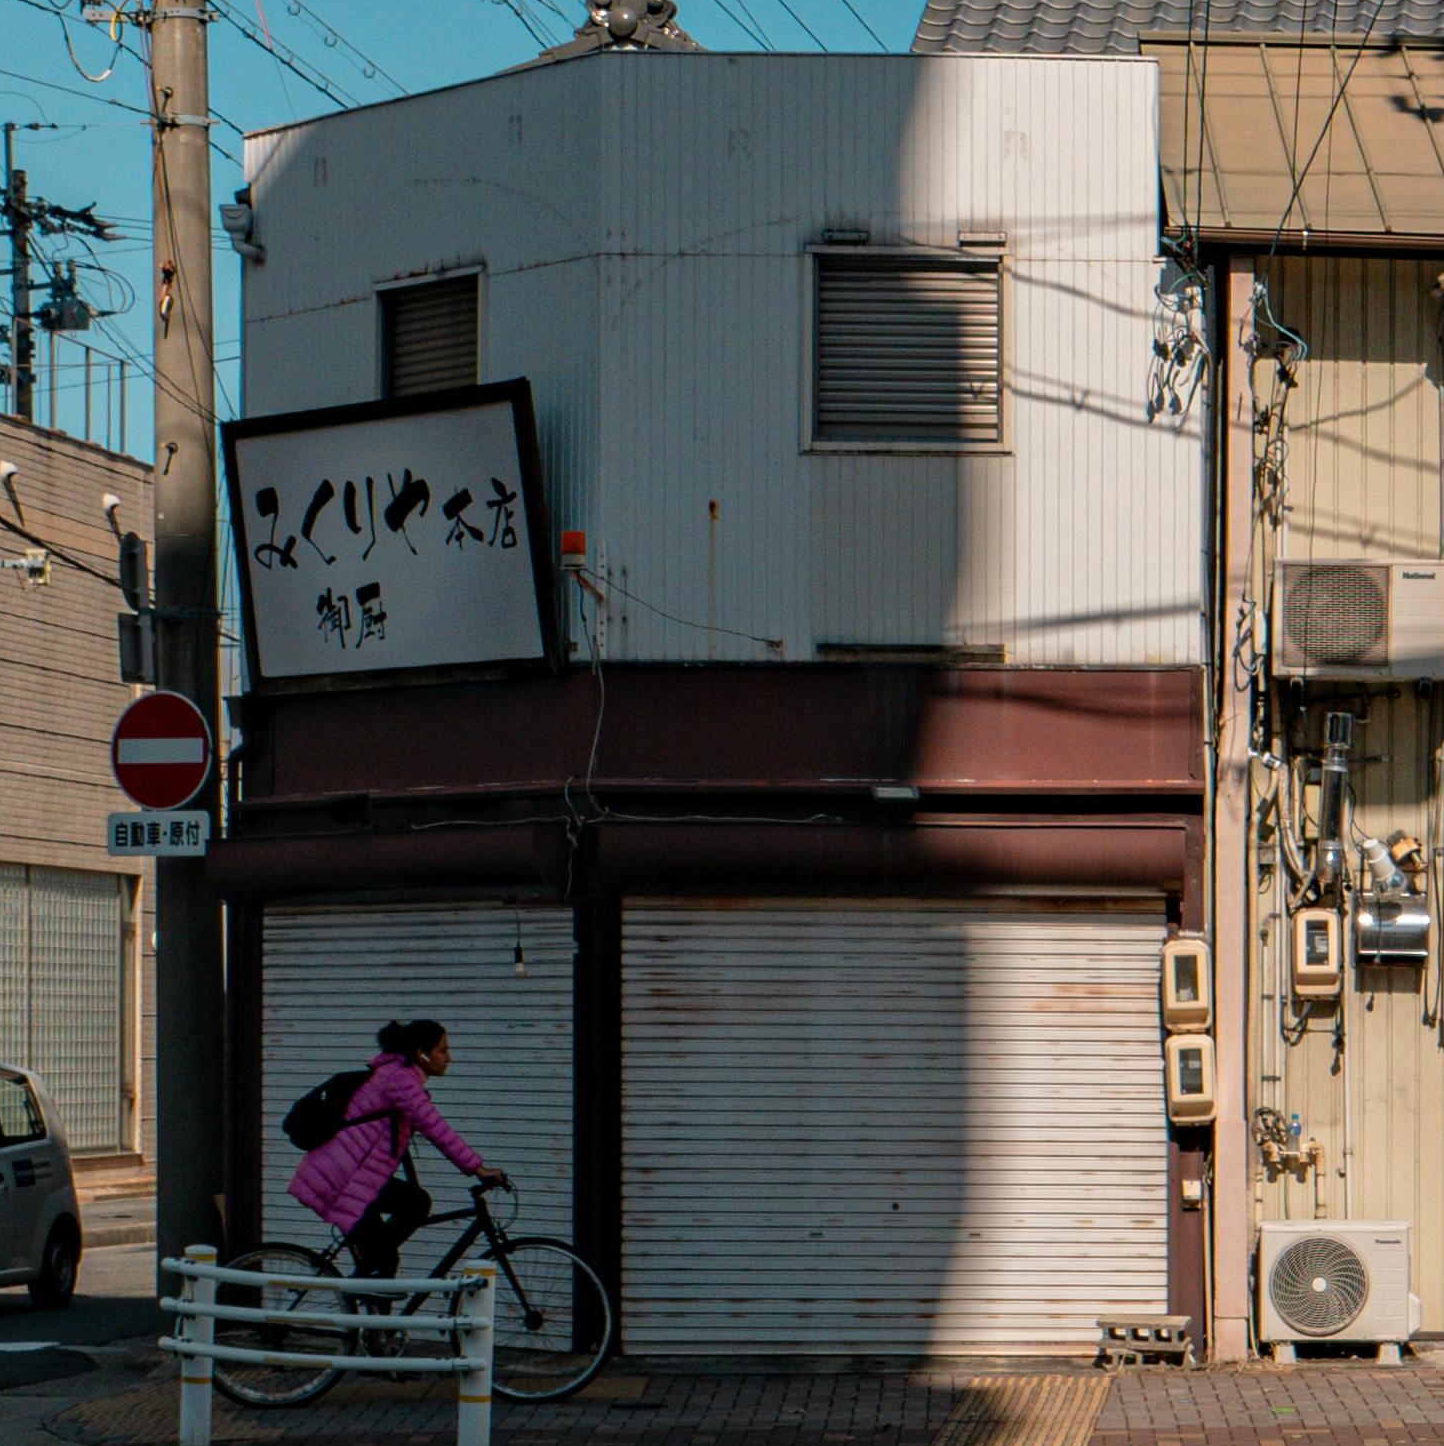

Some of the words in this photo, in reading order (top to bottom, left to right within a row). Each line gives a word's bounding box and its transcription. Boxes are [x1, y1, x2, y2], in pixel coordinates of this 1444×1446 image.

[254, 467, 518, 570] みくりや本店
[115, 821, 201, 847] 自動車・原付
